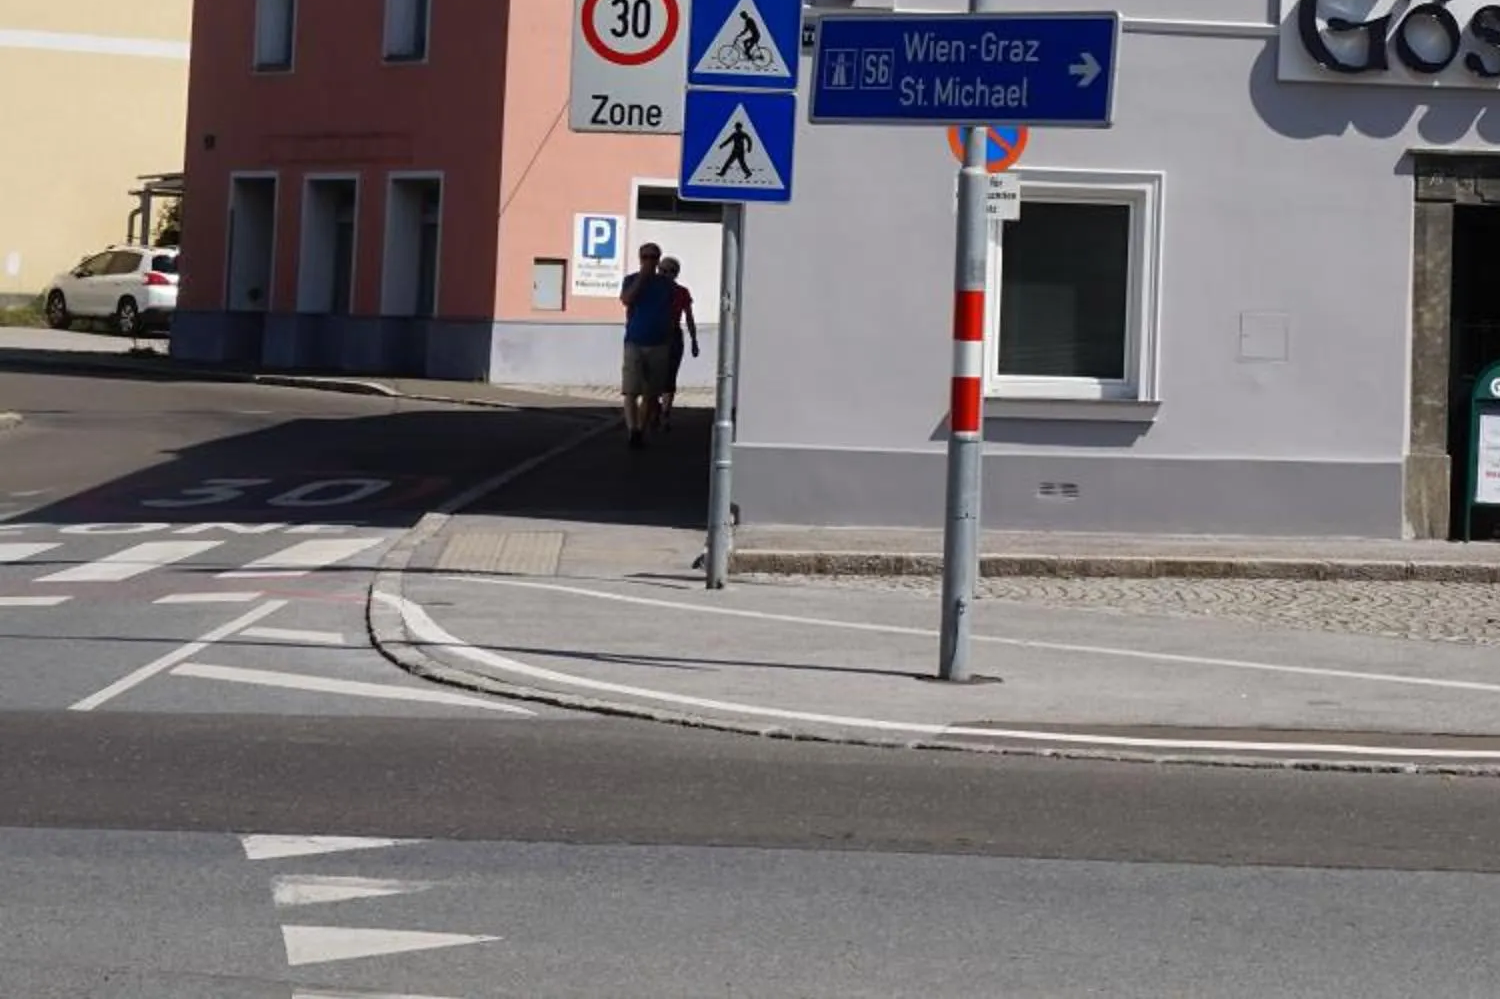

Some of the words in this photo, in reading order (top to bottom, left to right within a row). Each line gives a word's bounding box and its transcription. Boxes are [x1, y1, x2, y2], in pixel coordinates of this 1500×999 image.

[904, 31, 1041, 64] Wien-Graz
[864, 55, 890, 85] S6
[899, 78, 930, 106] St.
[936, 81, 1029, 109] Michael
[590, 94, 663, 127] Zone
[586, 220, 612, 256] P
